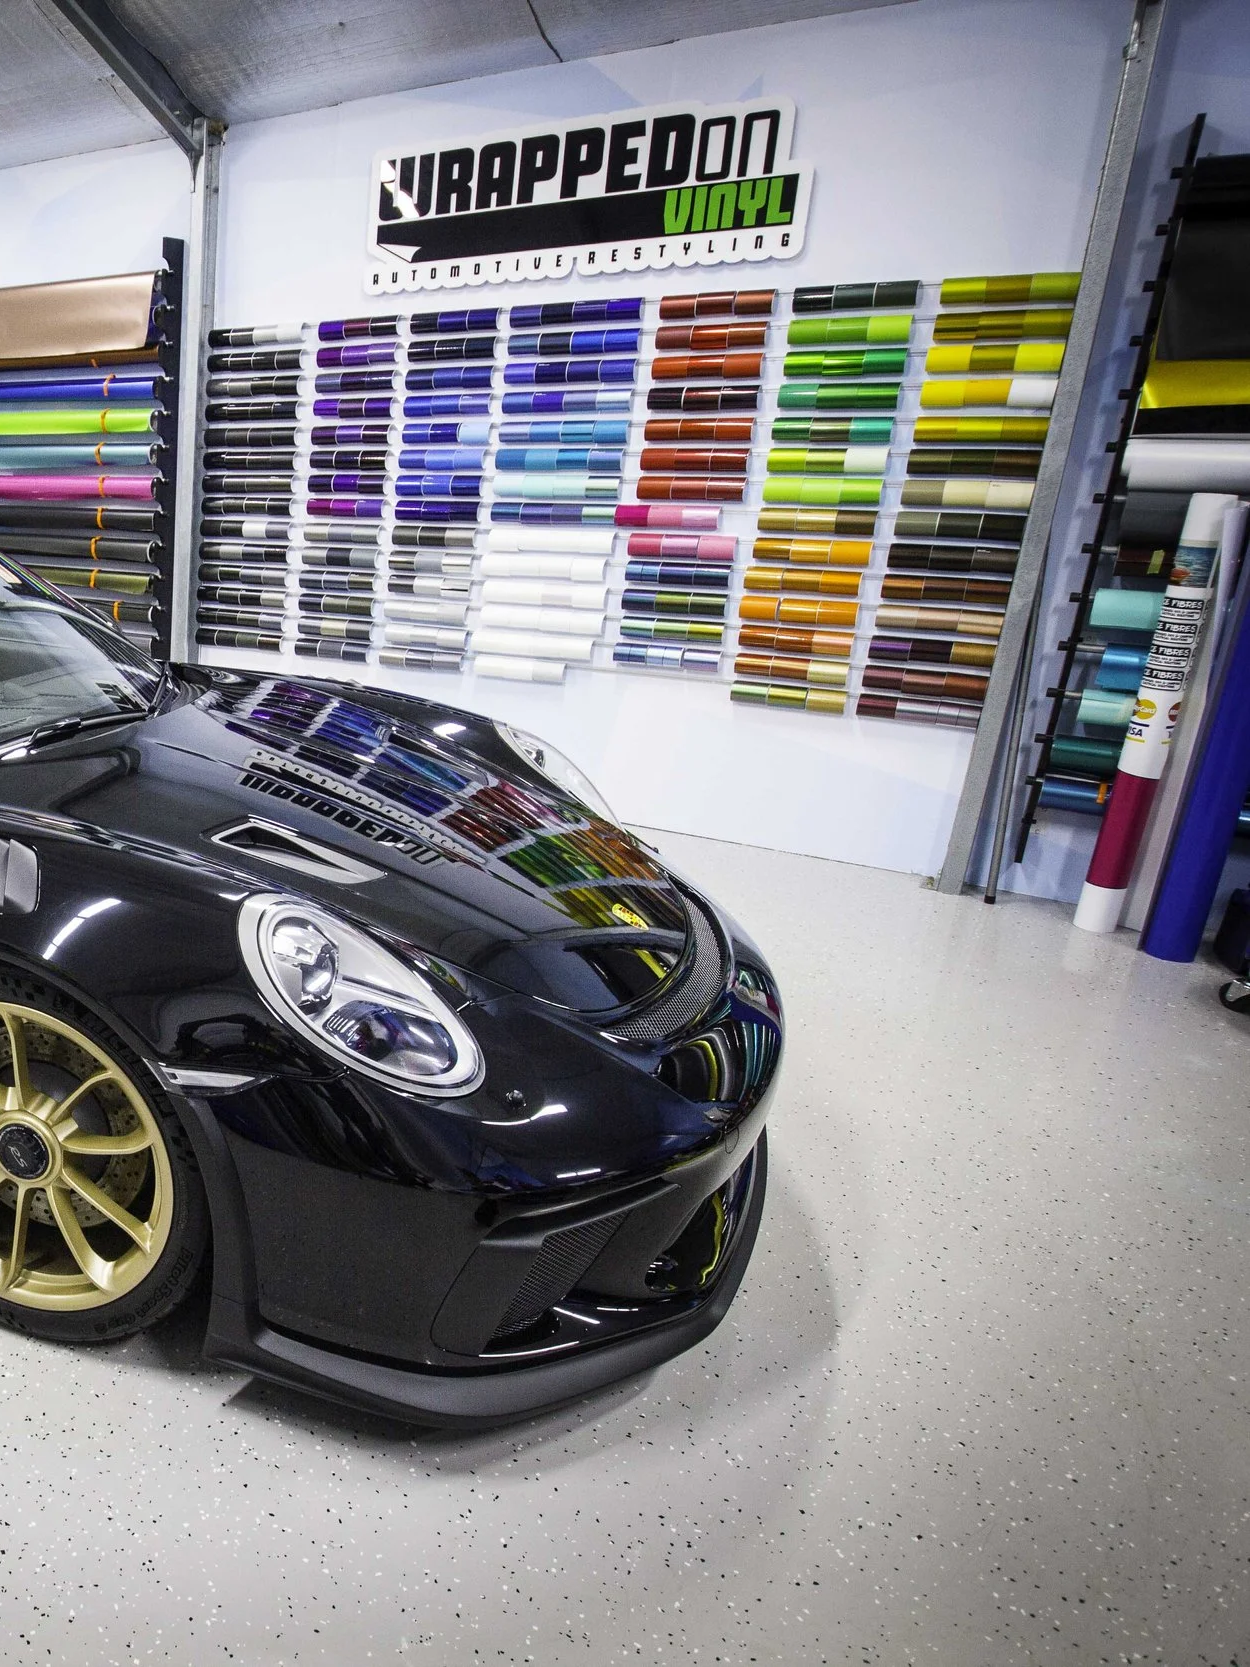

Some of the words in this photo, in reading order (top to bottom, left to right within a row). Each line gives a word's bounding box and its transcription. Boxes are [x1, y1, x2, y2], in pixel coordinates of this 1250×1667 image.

[663, 176, 792, 235] VINYL
[372, 254, 563, 286] AUTOMOTIVE
[587, 232, 791, 265] RESTYLING
[1171, 599, 1203, 609] FIBRES
[1164, 623, 1196, 633] FIBRES
[1158, 646, 1190, 657] FIBRES
[1152, 670, 1184, 680] FIBRES
[1128, 726, 1143, 737] ISA
